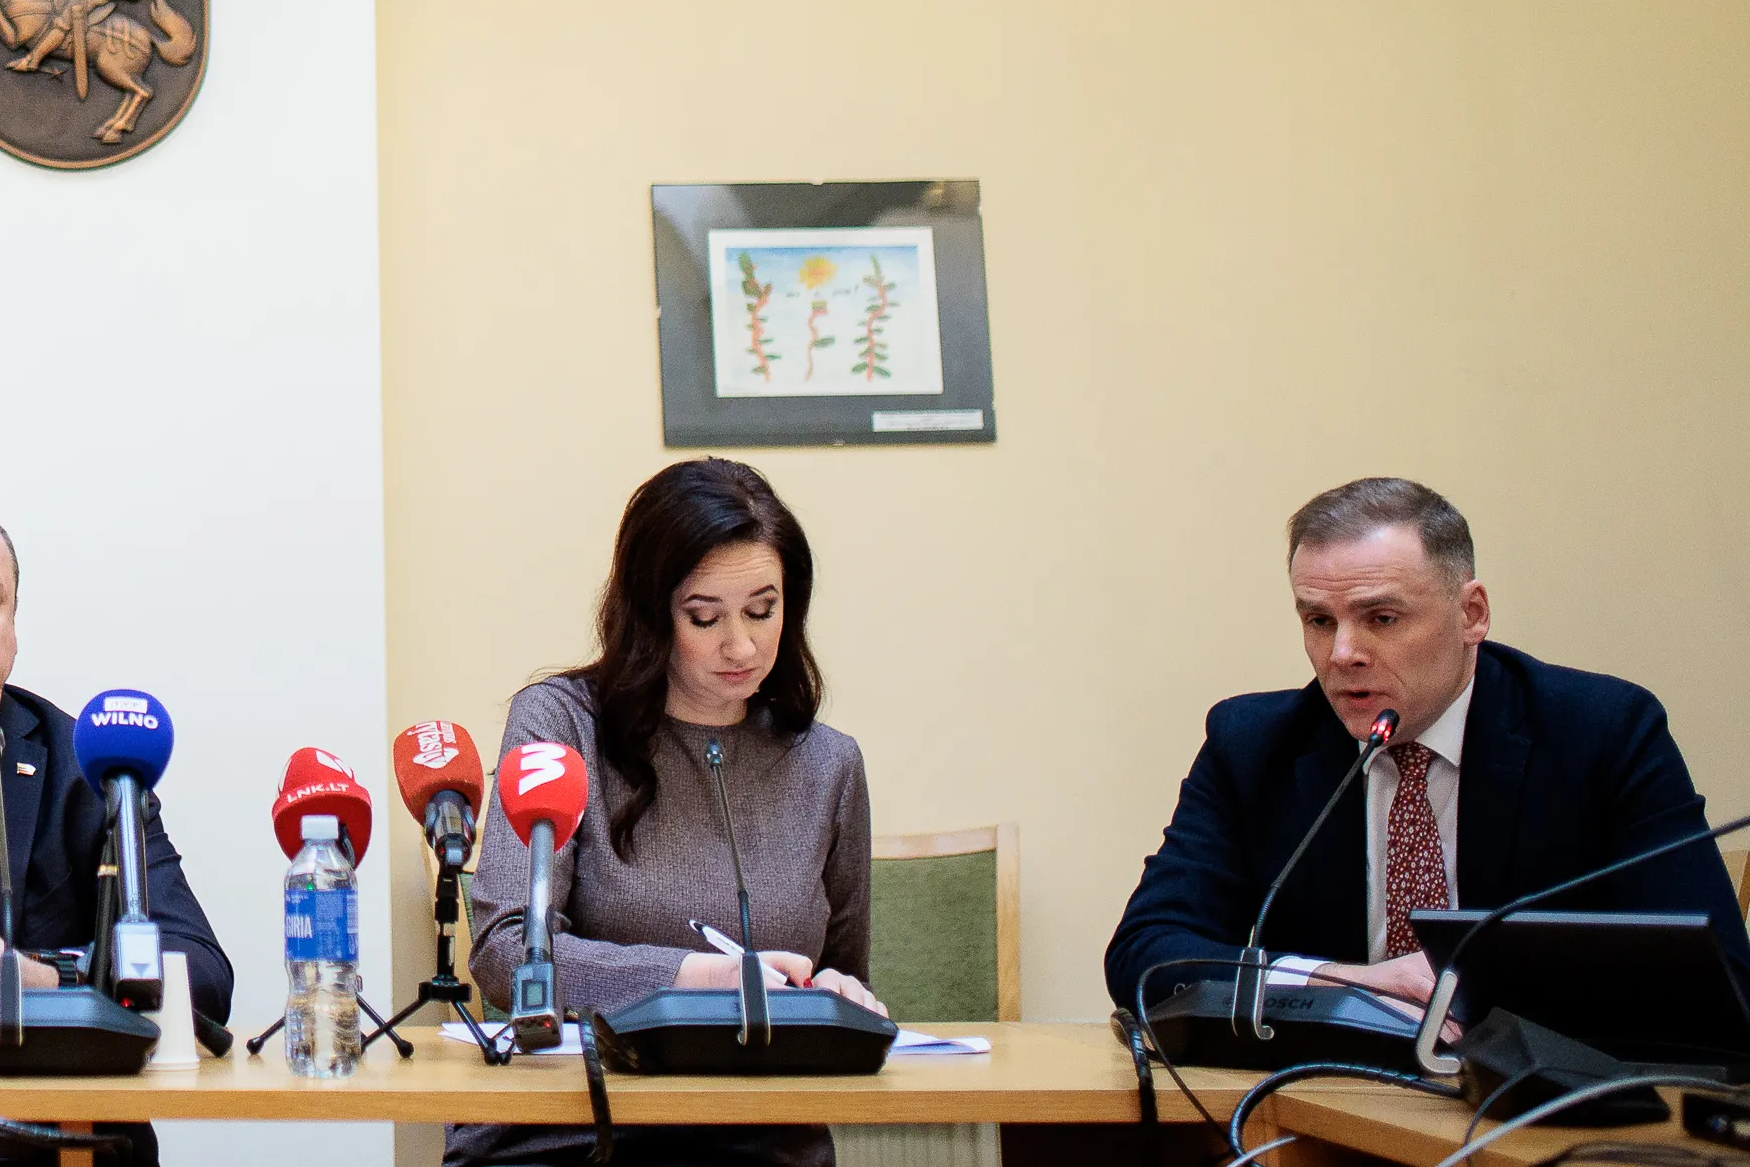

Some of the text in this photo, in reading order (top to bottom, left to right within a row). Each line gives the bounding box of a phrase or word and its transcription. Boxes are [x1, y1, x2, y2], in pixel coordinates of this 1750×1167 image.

[91, 712, 159, 730] WILNO
[287, 783, 350, 803] LNK.LT
[1264, 998, 1314, 1009] OSCH
